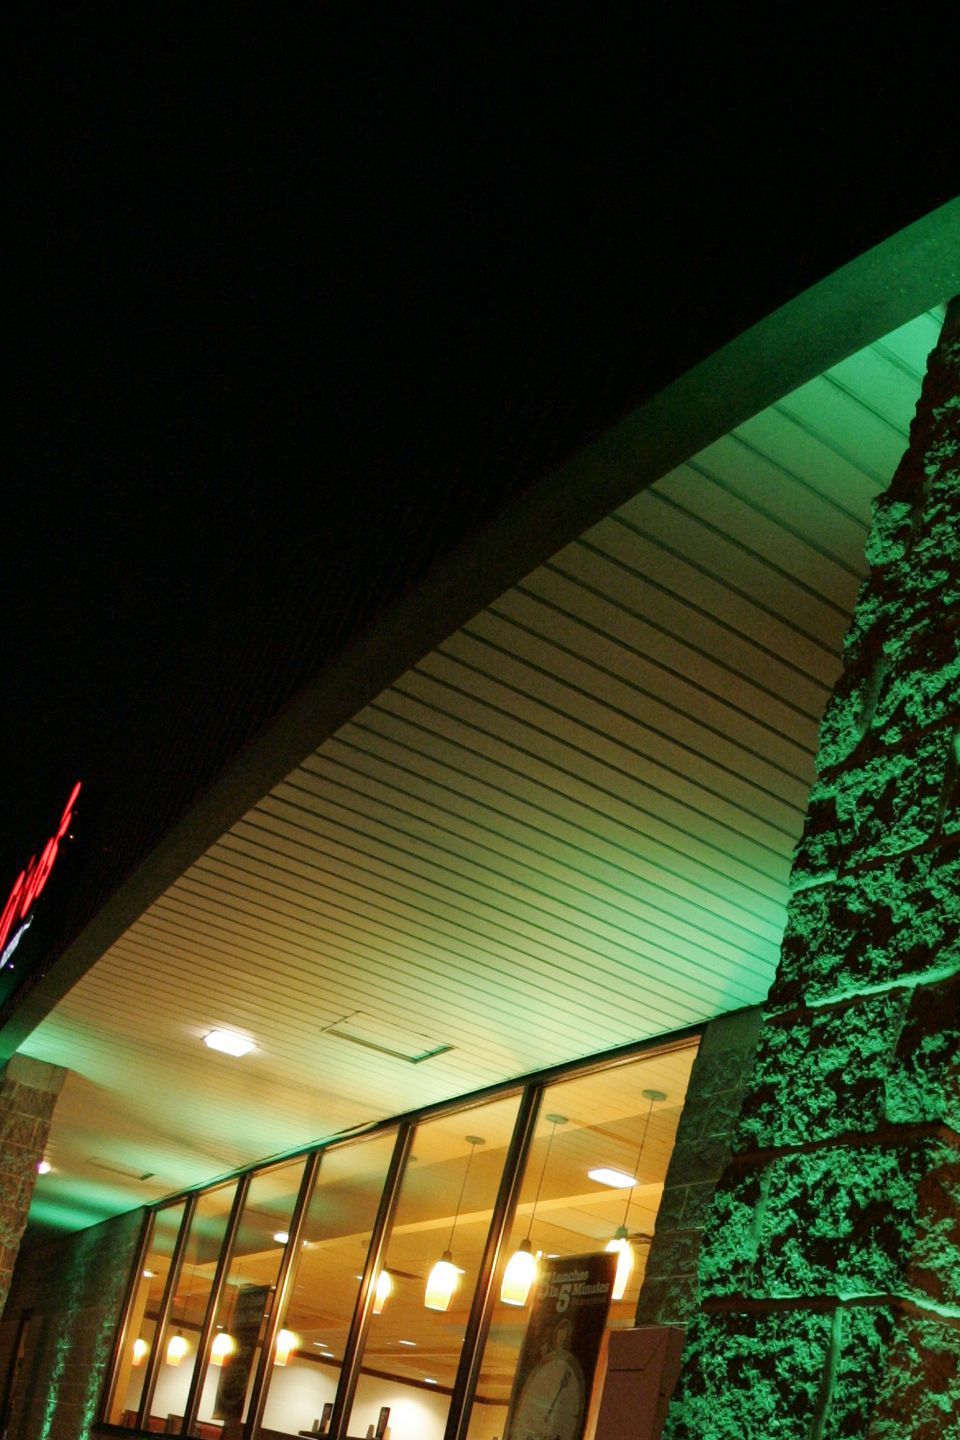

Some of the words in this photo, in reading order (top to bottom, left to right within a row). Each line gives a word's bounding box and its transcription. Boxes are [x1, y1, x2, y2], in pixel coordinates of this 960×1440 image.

[551, 1270, 589, 1283] Lunches
[556, 1284, 572, 1312] 5
[571, 1282, 609, 1296] Minutes
